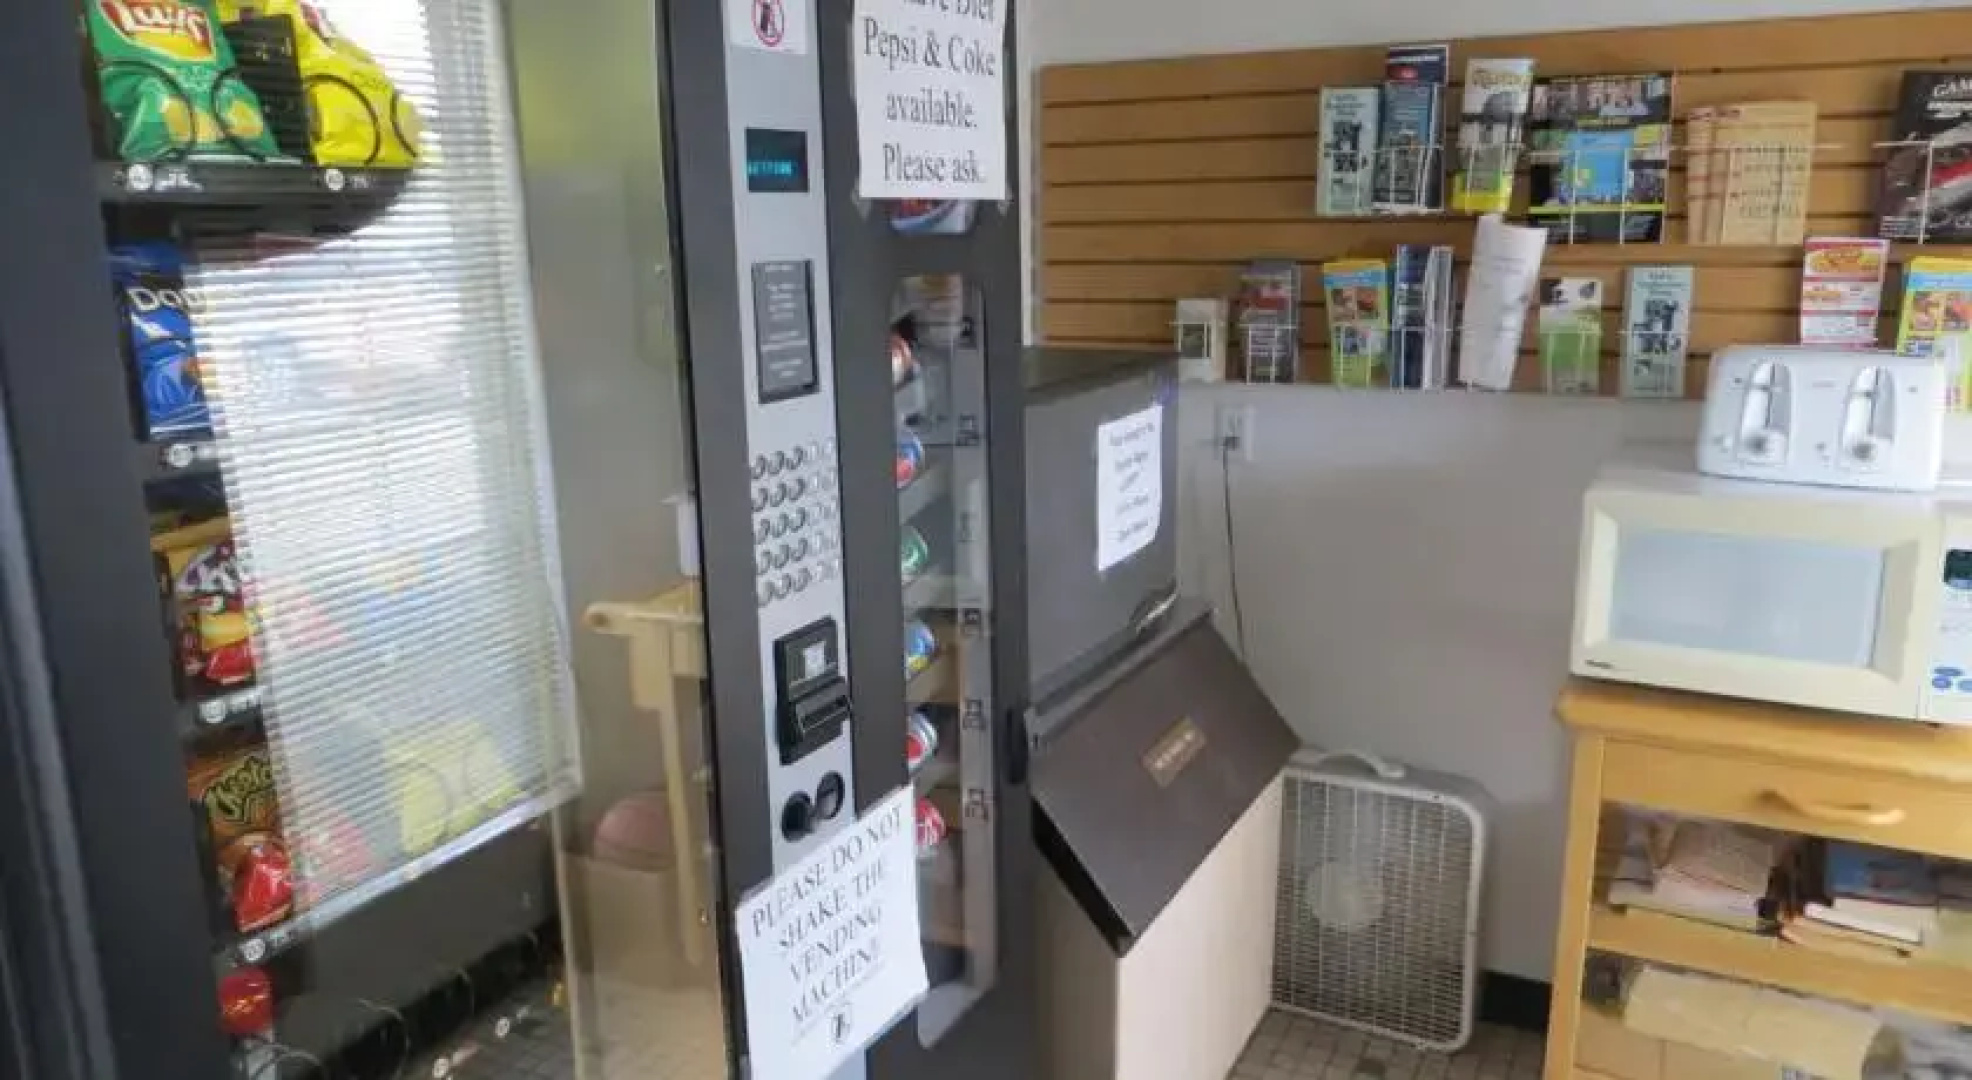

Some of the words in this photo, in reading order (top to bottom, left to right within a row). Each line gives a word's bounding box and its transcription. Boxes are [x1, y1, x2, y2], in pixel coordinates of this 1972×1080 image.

[863, 16, 918, 71] Pepsi
[923, 29, 942, 68] &
[949, 34, 996, 77] Coke
[886, 86, 978, 128] available.
[882, 142, 946, 182] Please
[751, 863, 826, 937] PLEASE
[831, 834, 864, 873] DO
[866, 804, 902, 844] NOT
[779, 886, 846, 949] SHAKE
[852, 858, 886, 898] THE
[789, 905, 882, 983] VENDING
